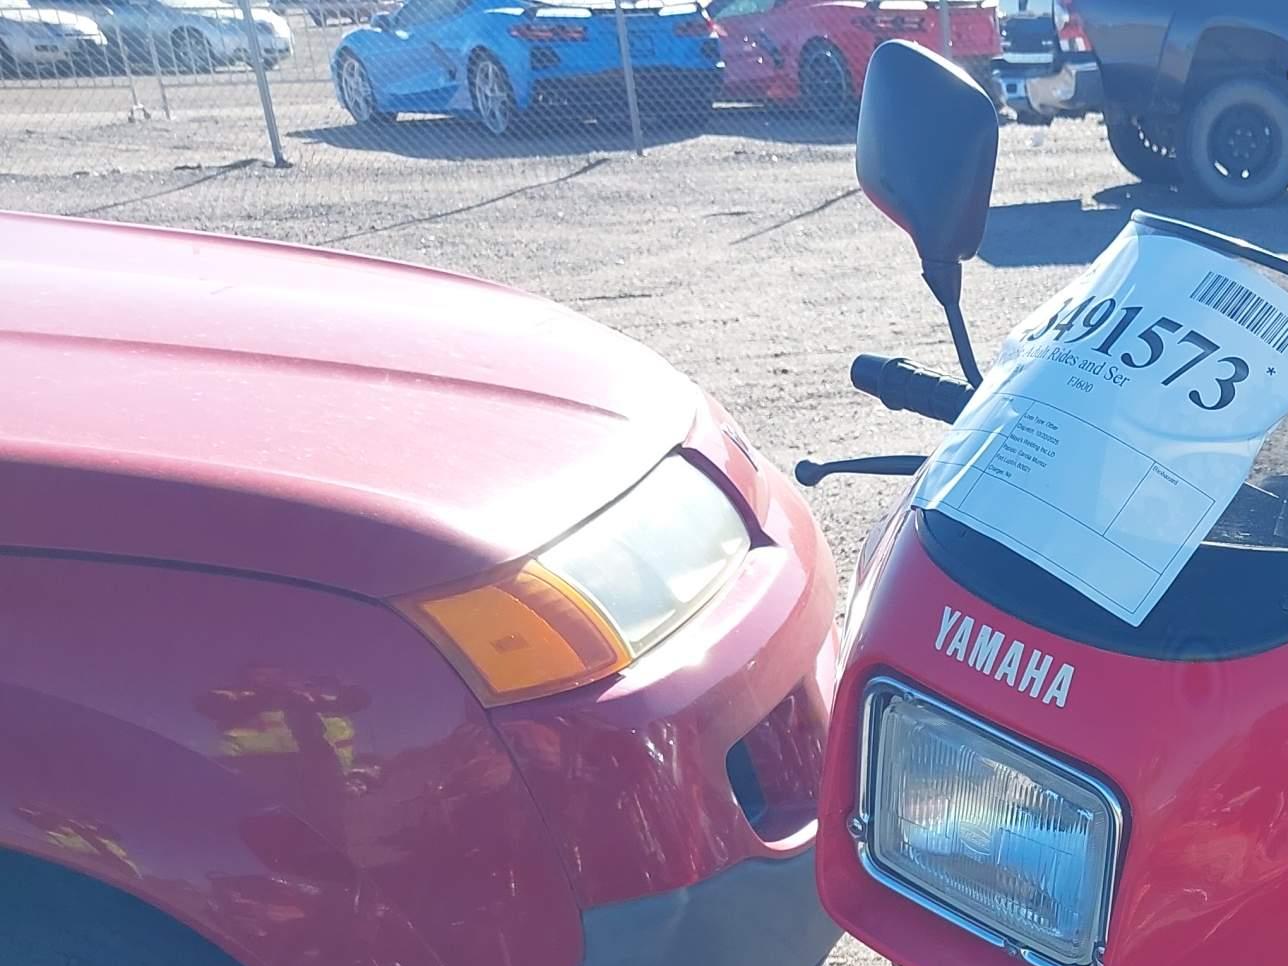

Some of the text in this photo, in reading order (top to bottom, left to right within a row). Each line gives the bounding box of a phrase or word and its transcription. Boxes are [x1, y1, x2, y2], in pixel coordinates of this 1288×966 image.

[1047, 346, 1079, 367] Rides
[1078, 359, 1106, 376] and
[1104, 365, 1130, 387] Ser
[1066, 375, 1094, 393] FJ600
[935, 606, 1075, 708] YAMAHA
